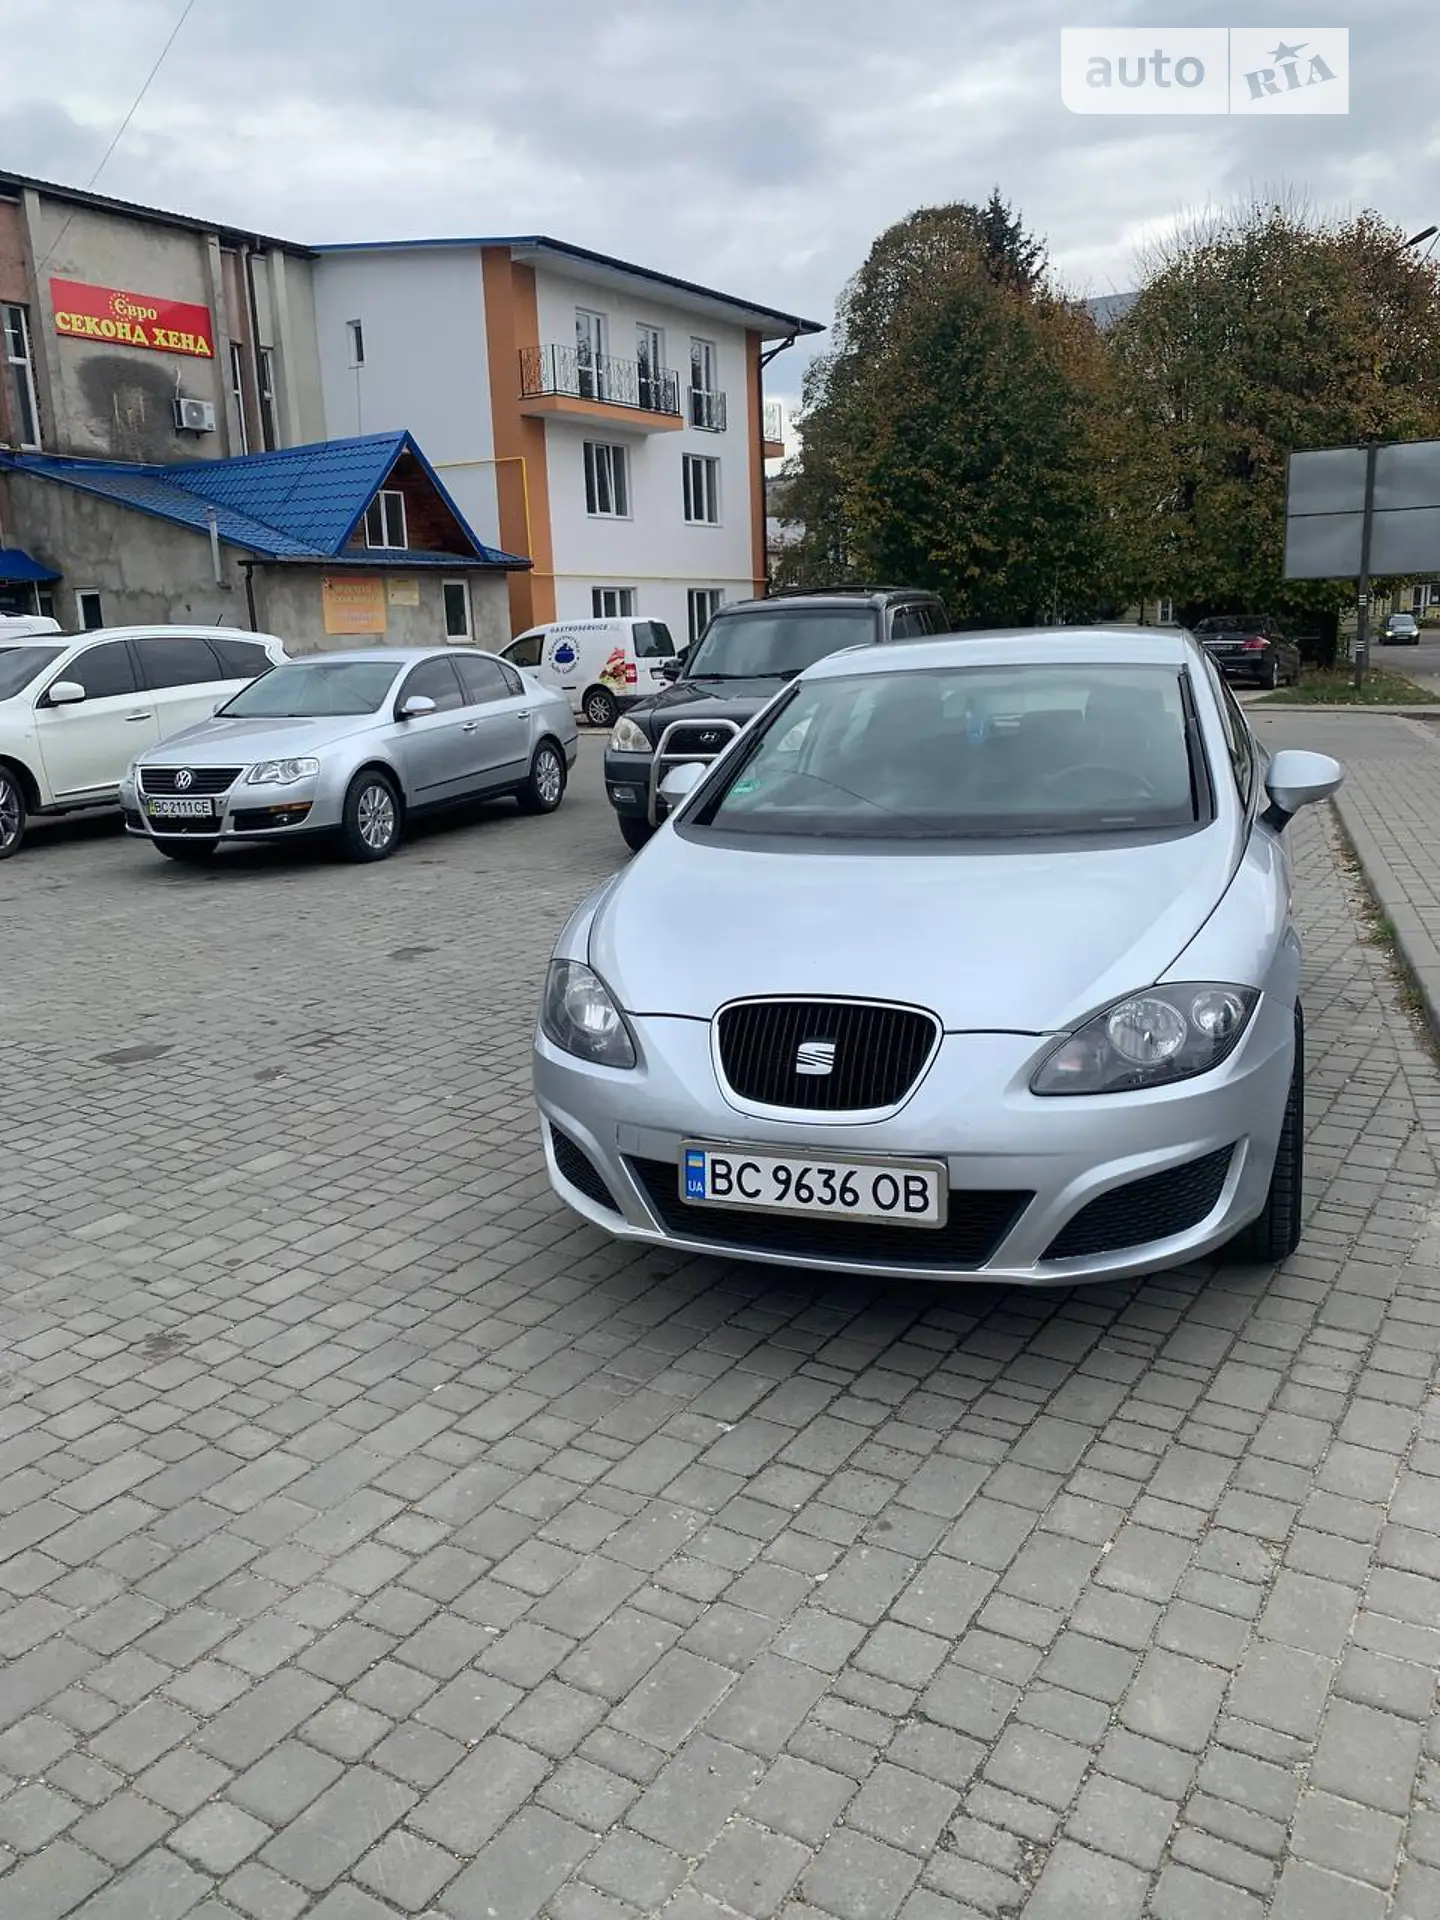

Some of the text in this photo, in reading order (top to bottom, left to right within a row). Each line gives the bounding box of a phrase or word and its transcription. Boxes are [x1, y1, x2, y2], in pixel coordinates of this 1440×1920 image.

[114, 298, 157, 321] Євро
[55, 311, 211, 356] СЕКОНД ХЕНД
[688, 1181, 704, 1193] UA
[710, 1158, 929, 1213] BC 9636 OB
